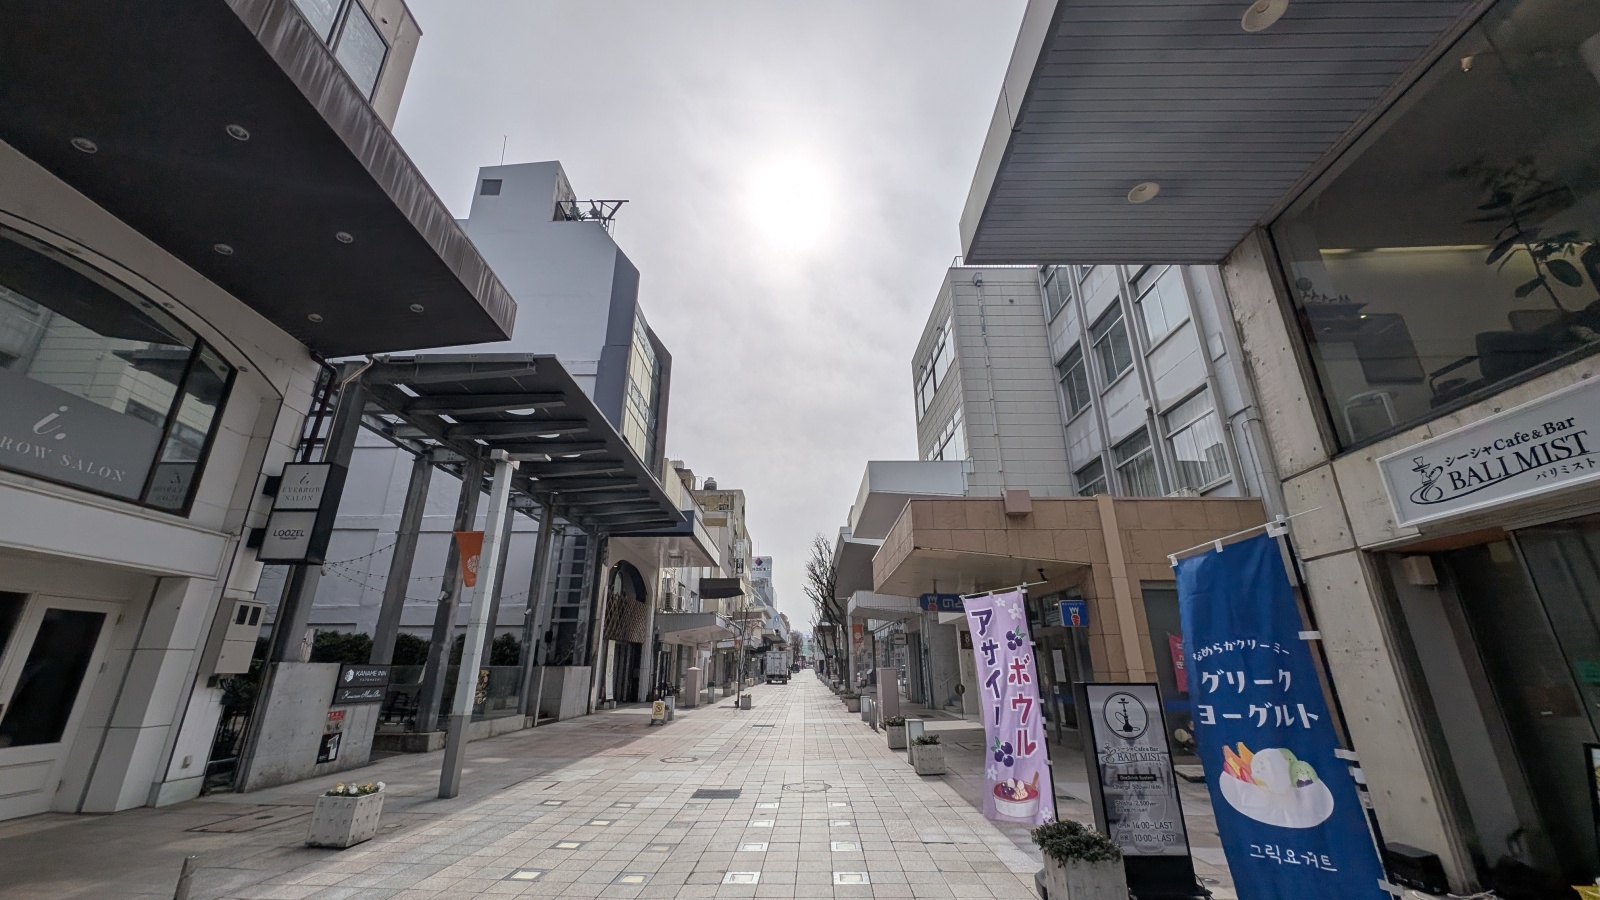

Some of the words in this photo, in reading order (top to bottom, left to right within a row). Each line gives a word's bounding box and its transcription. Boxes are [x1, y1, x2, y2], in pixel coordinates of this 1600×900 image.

[60, 454, 126, 482] SALON
[1447, 456, 1511, 491] BALI
[1513, 430, 1590, 472] MIST
[1536, 457, 1596, 481] バリミスト
[273, 529, 305, 537] LOOZEL
[1192, 639, 1290, 661] なめらかクリーミー
[970, 608, 1001, 726] アサイー
[1201, 668, 1292, 694] グリーク
[1008, 654, 1038, 757] ボウル
[1197, 702, 1319, 729] ヨーグルト
[1117, 752, 1138, 761] BALI
[1139, 752, 1162, 761] MIST
